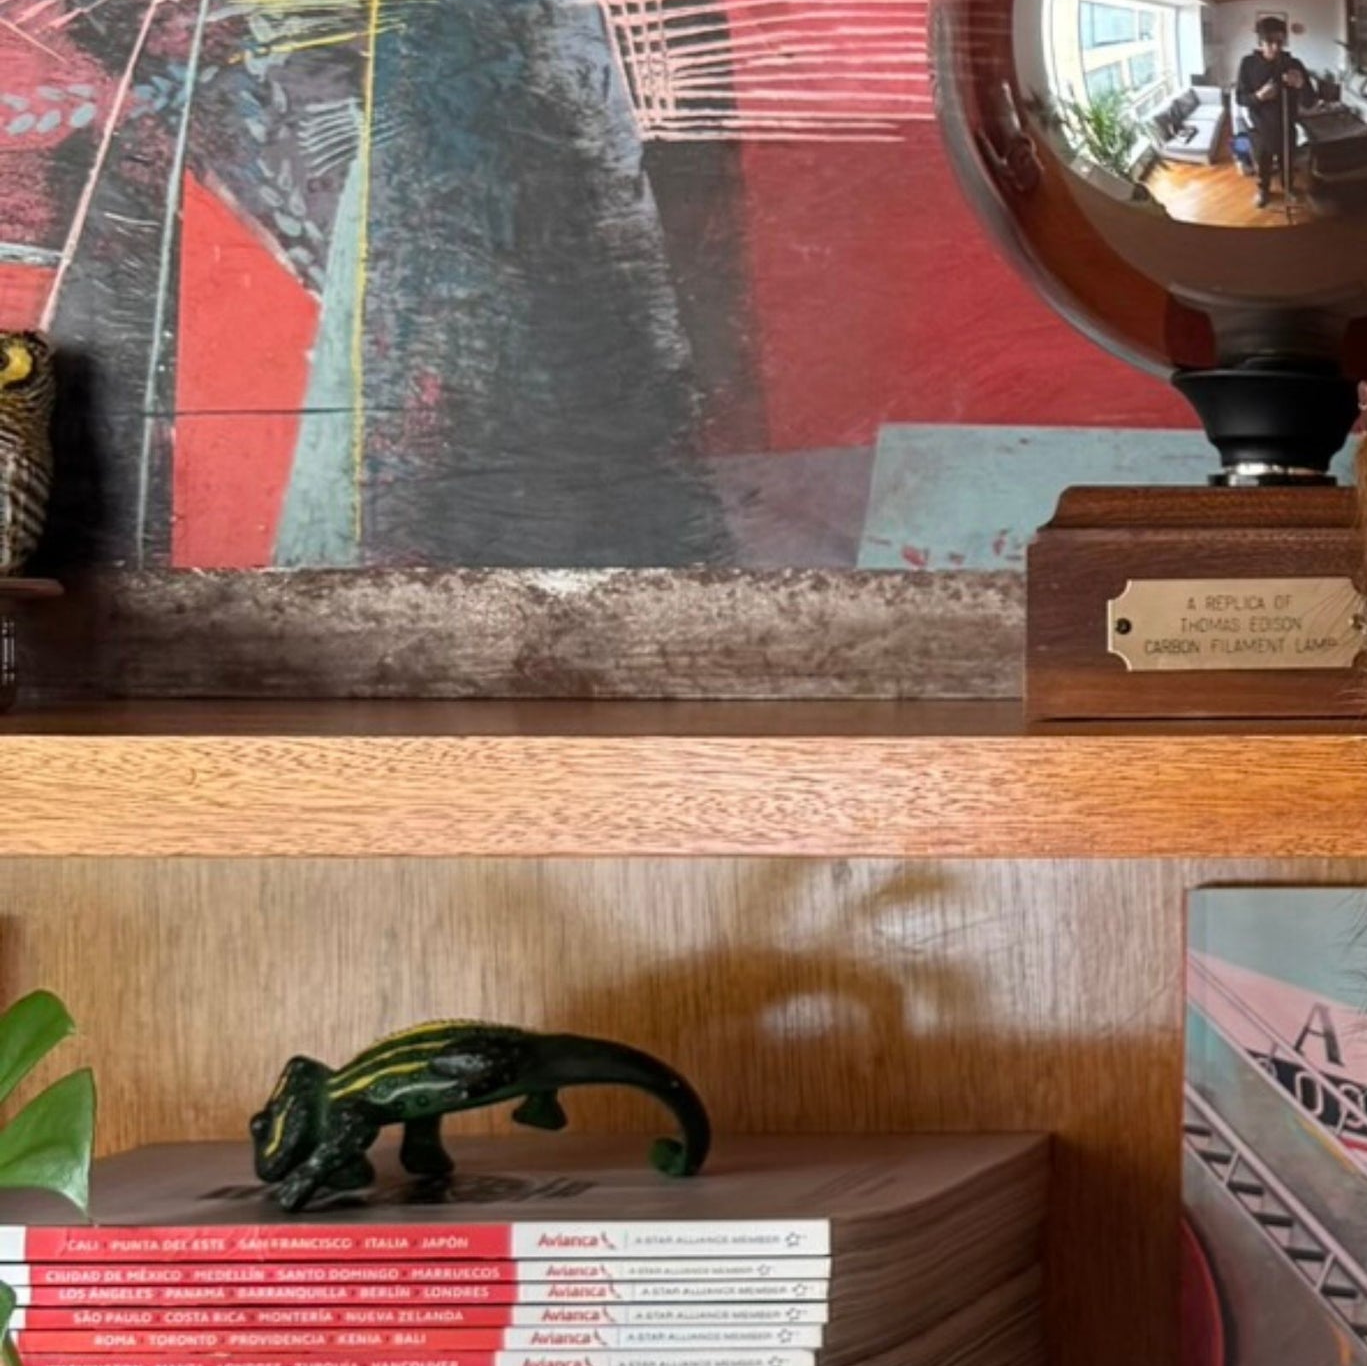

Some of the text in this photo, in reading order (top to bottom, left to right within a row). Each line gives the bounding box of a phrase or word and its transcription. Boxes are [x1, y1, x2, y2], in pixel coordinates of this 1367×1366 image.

[1205, 595, 1266, 612] REPLICA
[1179, 616, 1303, 634] THOMAS EDISON
[1144, 639, 1200, 655] CARBON
[1210, 638, 1287, 654] FILAMENT
[538, 1232, 599, 1247] Avianca
